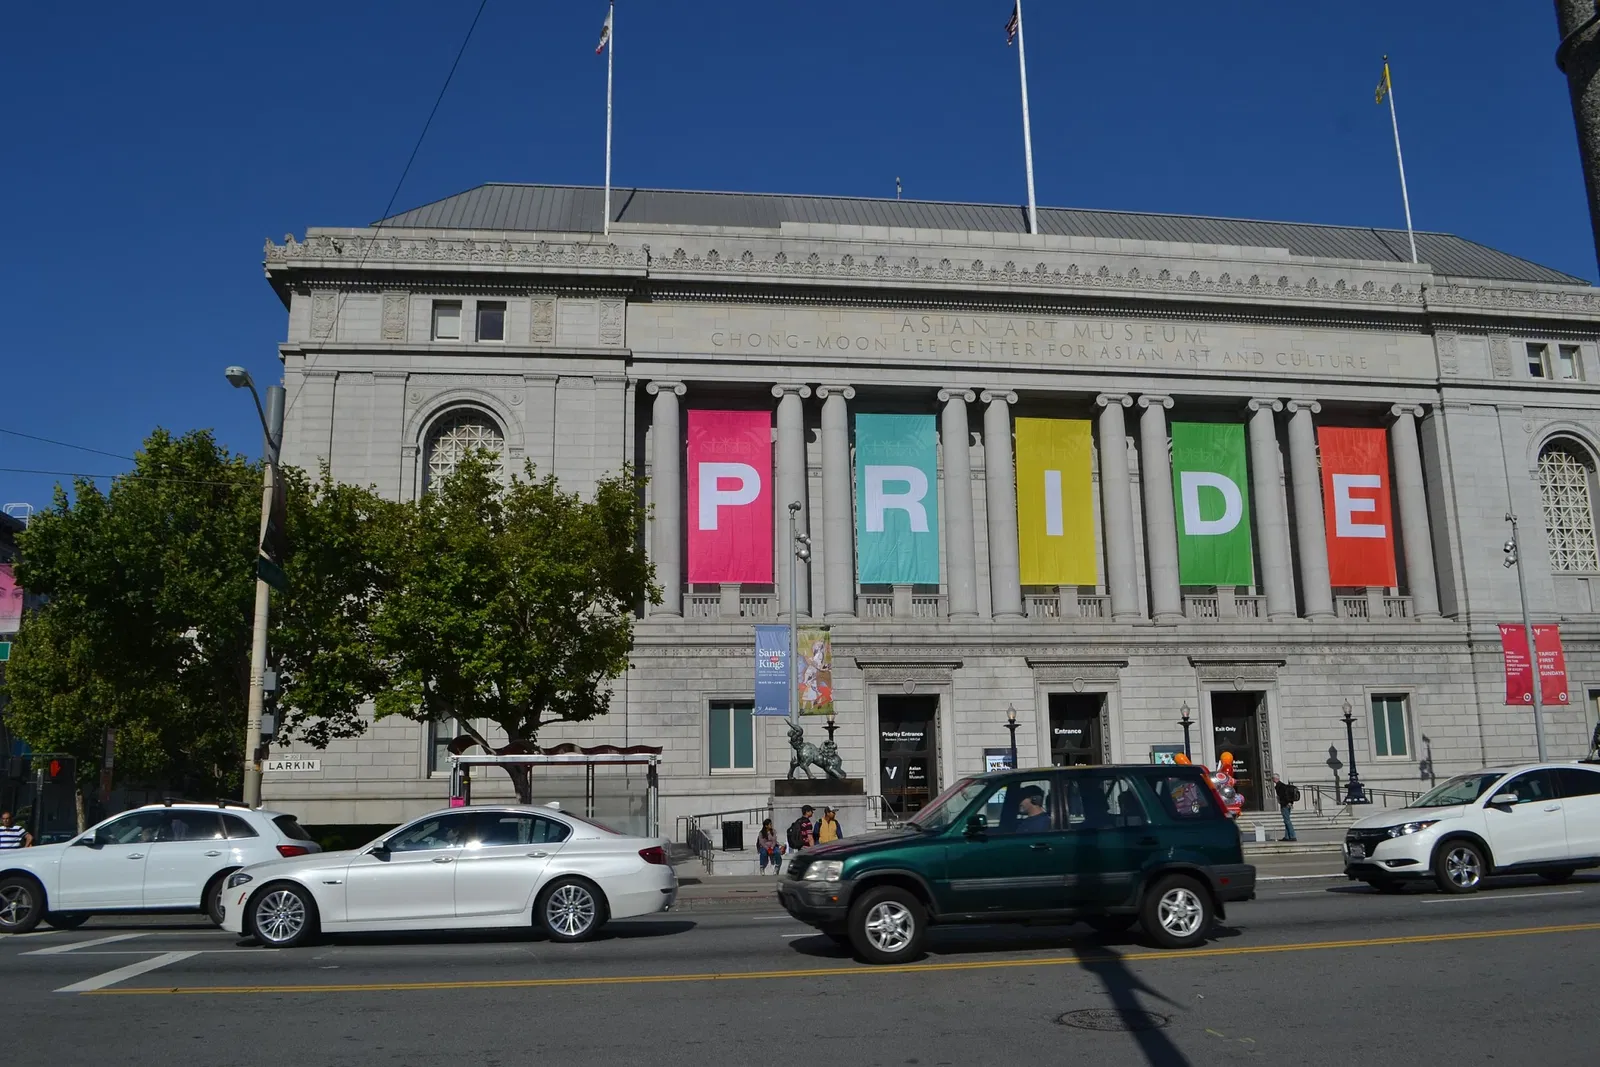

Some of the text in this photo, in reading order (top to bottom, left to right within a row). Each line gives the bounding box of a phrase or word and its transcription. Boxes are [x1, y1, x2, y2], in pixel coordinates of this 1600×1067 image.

[900, 316, 1203, 344] ASIAN ART MUSEUM
[711, 332, 1369, 370] CHONG-MOON LEE CENTER FOR ASIAN ART AND CULTURE
[759, 648, 786, 657] Saints
[759, 659, 785, 671] Kings
[268, 761, 315, 770] LARKIN
